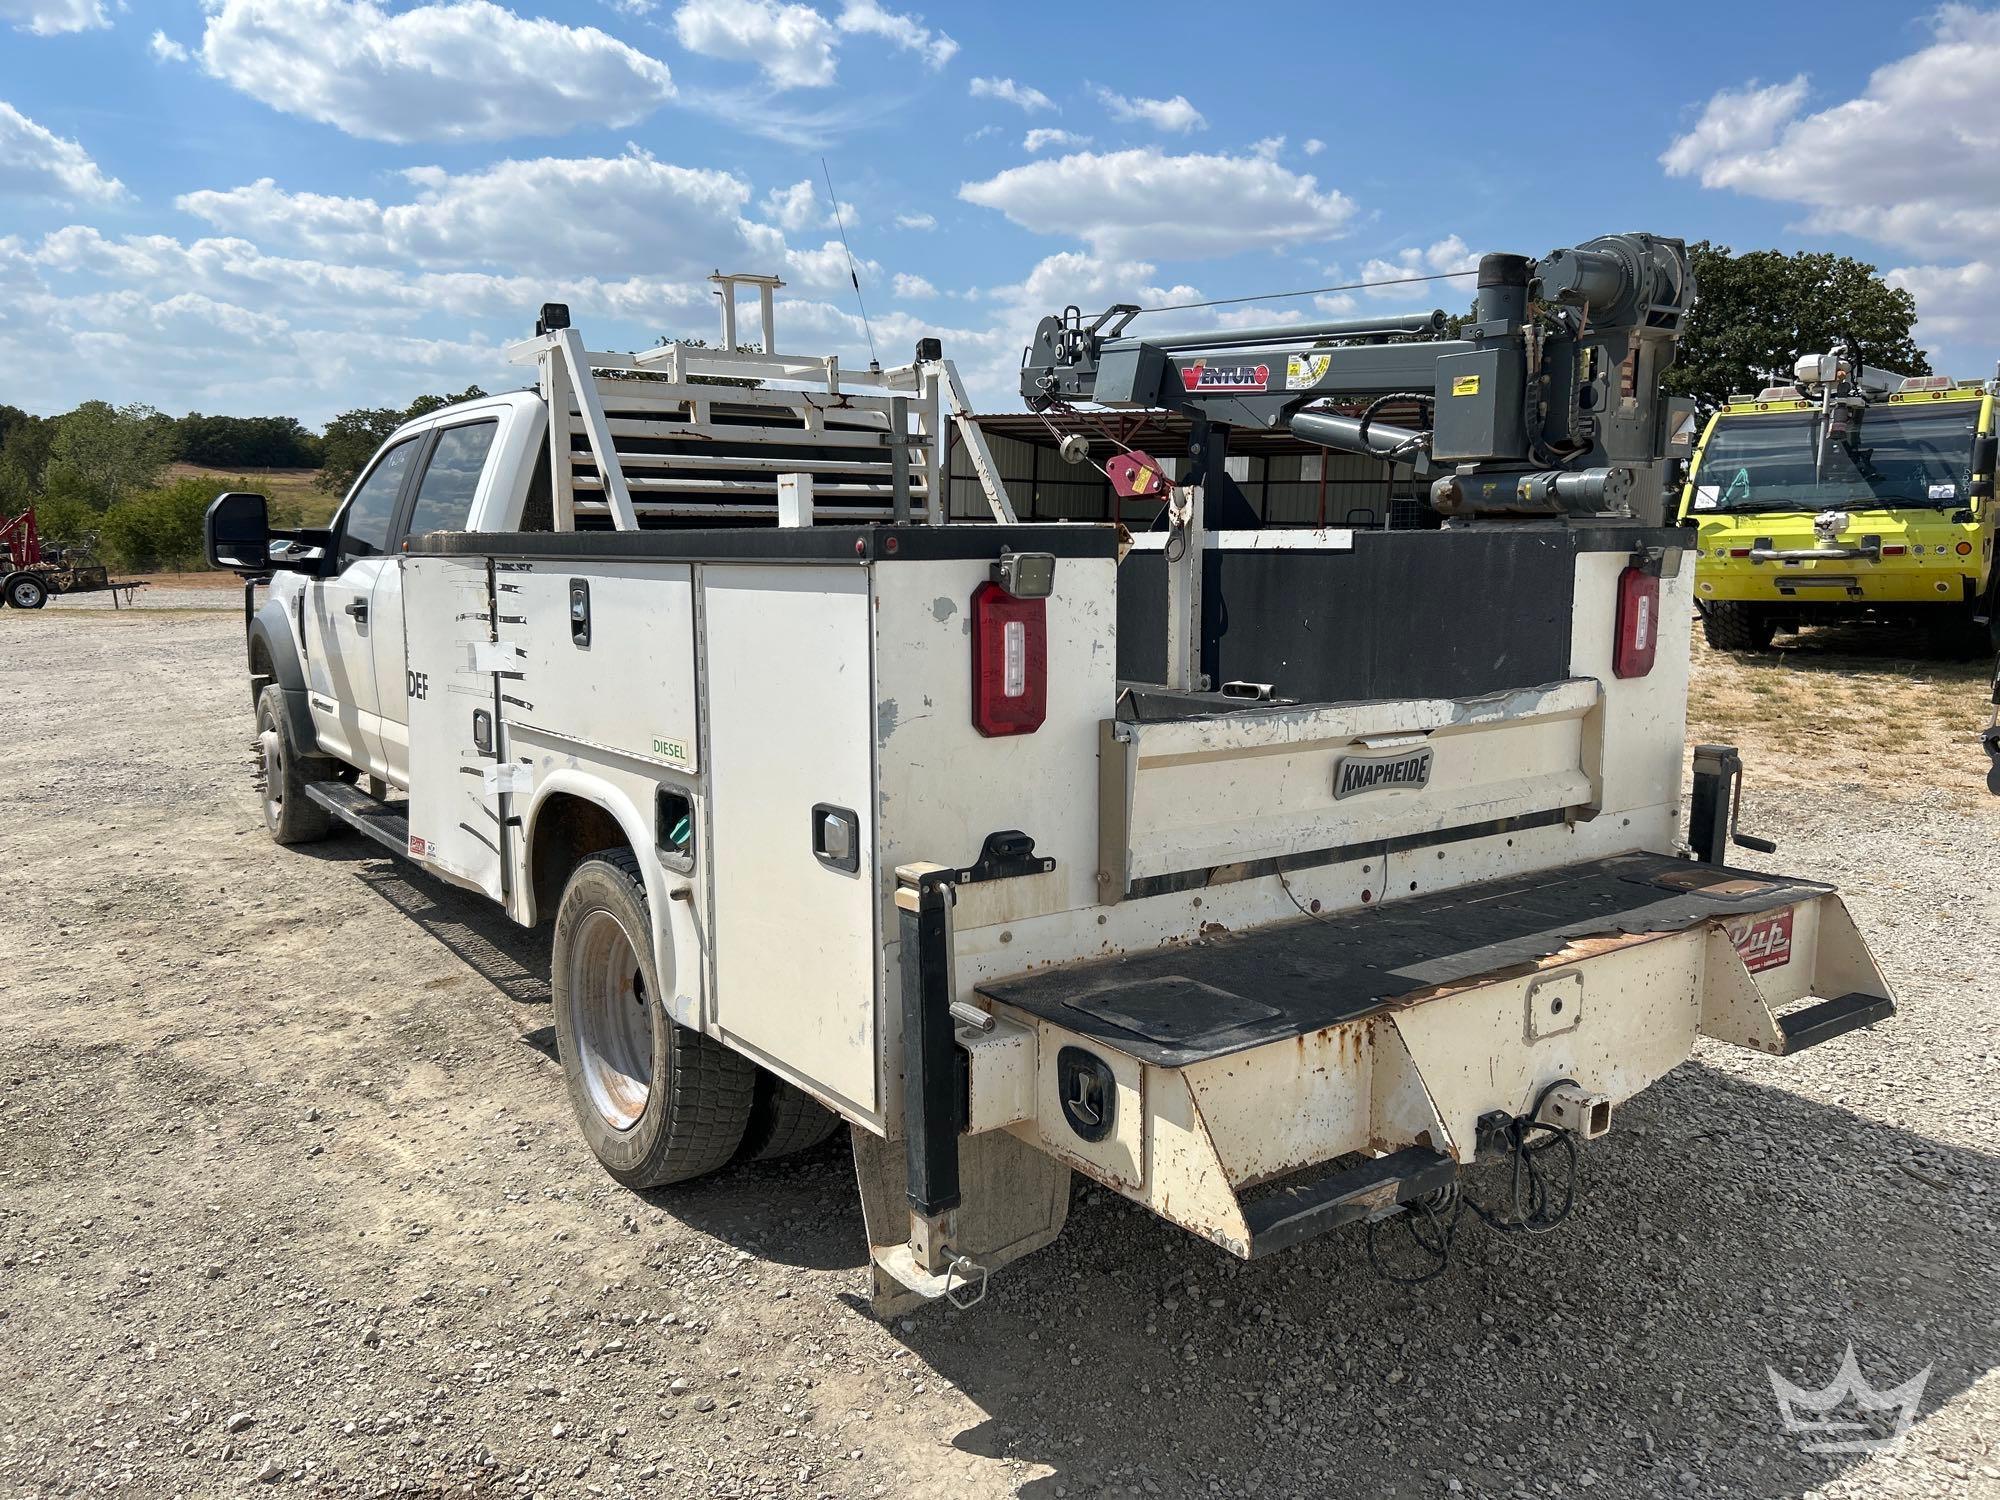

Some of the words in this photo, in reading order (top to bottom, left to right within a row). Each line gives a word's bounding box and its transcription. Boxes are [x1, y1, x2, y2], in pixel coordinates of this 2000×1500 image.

[1182, 364, 1269, 391] VENTURO
[408, 670, 429, 700] DEF
[653, 739, 686, 760] DIESEL
[1341, 754, 1430, 793] KNAPHEIDE
